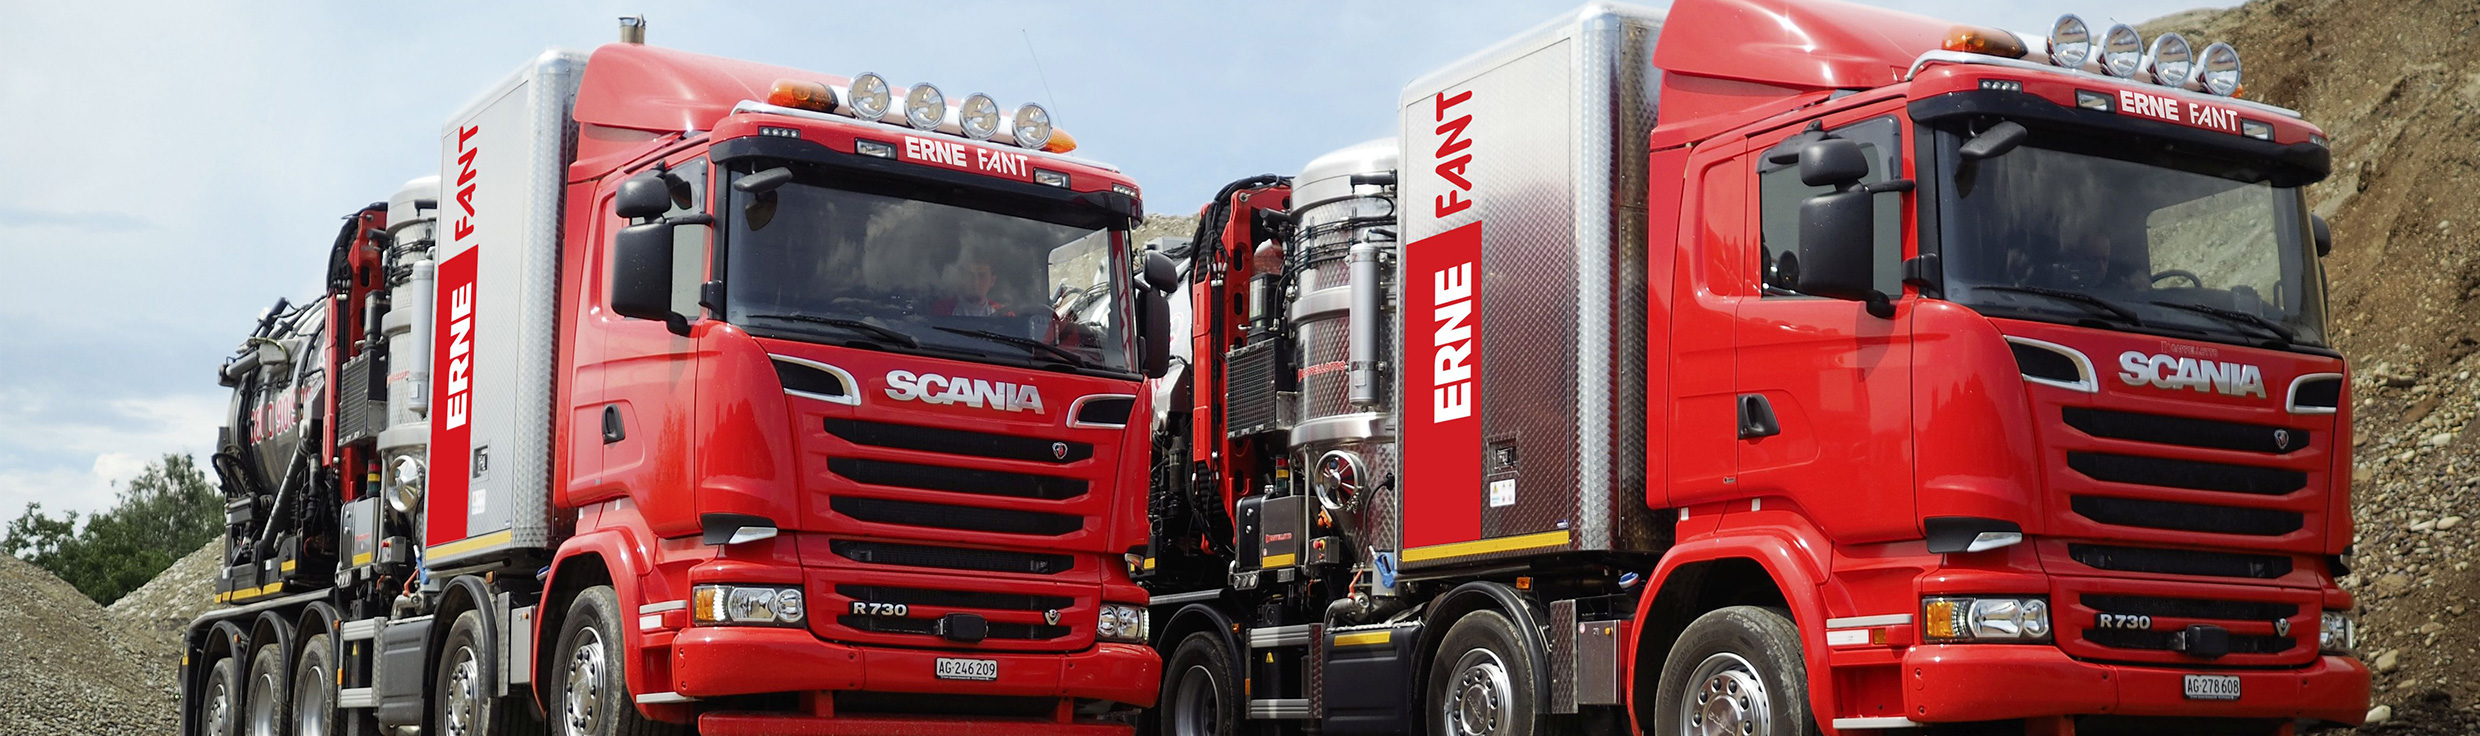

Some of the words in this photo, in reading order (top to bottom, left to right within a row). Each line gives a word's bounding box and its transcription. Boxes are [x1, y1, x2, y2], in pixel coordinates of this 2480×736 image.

[2119, 90, 2180, 121] ERNE
[2188, 102, 2238, 132] FANT
[904, 135, 967, 168] ERNE
[977, 147, 1029, 177] FANT
[1435, 90, 1472, 218] FANT
[455, 125, 478, 242] FANT
[446, 281, 472, 431] ERNE
[1434, 261, 1472, 423] ERNE
[884, 369, 1046, 415] SCANIA
[2118, 350, 2267, 398] SCANIA
[853, 602, 866, 615] R
[869, 602, 907, 617] 730
[2100, 613, 2112, 628] R
[2115, 614, 2151, 630] 730
